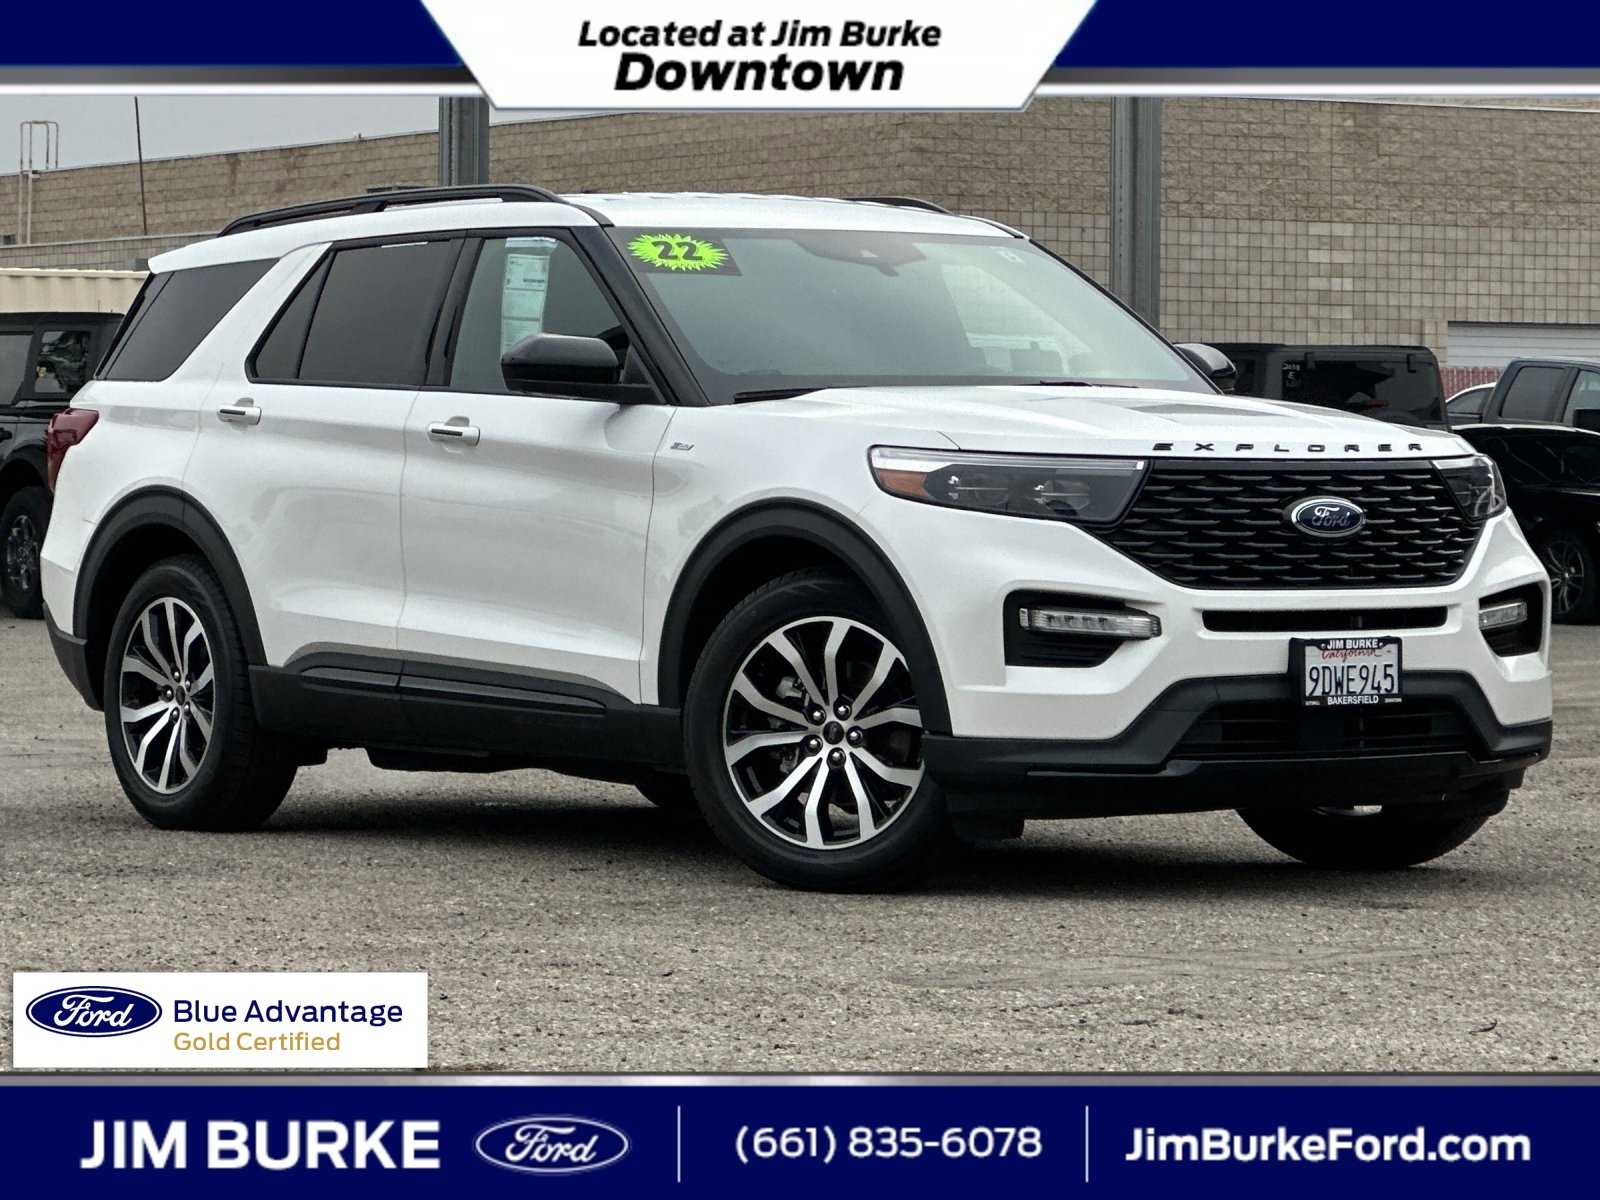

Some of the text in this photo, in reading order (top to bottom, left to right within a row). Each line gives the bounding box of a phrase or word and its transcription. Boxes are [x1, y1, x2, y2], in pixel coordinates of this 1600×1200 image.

[651, 240, 703, 261] 22
[1152, 442, 1423, 453] EXPLORER
[1311, 506, 1351, 527] Ford
[1327, 639, 1379, 650] JIM BURKE
[1321, 649, 1382, 663] California
[1309, 664, 1395, 696] 9DWE945
[1327, 695, 1379, 706] BAKERSFIELD
